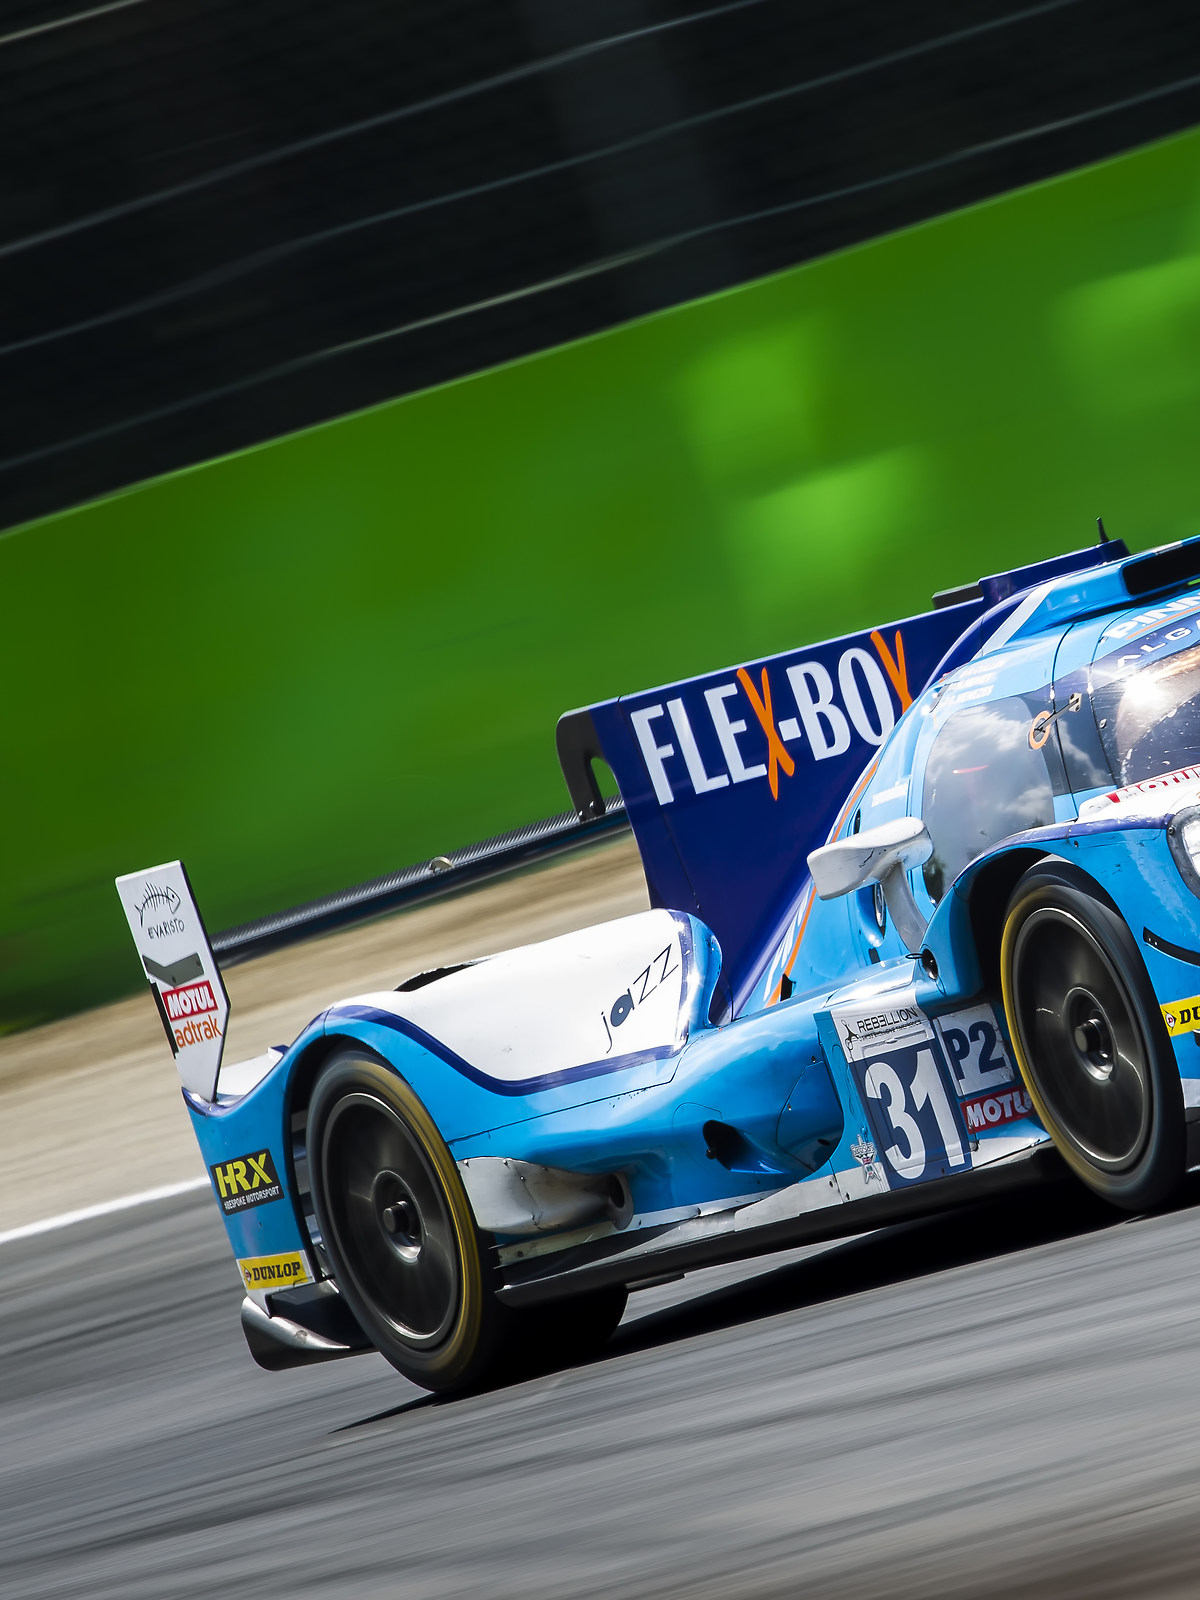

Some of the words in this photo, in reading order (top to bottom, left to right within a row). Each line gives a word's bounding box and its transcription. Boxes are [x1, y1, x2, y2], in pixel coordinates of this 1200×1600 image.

[147, 918, 185, 940] EVARISTO
[166, 984, 215, 1019] MOTUL
[601, 943, 679, 1054] jazz
[174, 1014, 223, 1048] adtrak
[856, 1006, 919, 1033] REBELLION
[941, 1021, 1007, 1080] P2
[864, 1048, 966, 1180] 31
[966, 1089, 1034, 1130] MOTU
[215, 1153, 273, 1198] HRX
[245, 1185, 280, 1204] MOTORSPORT
[252, 1261, 301, 1281] DUNLOP
